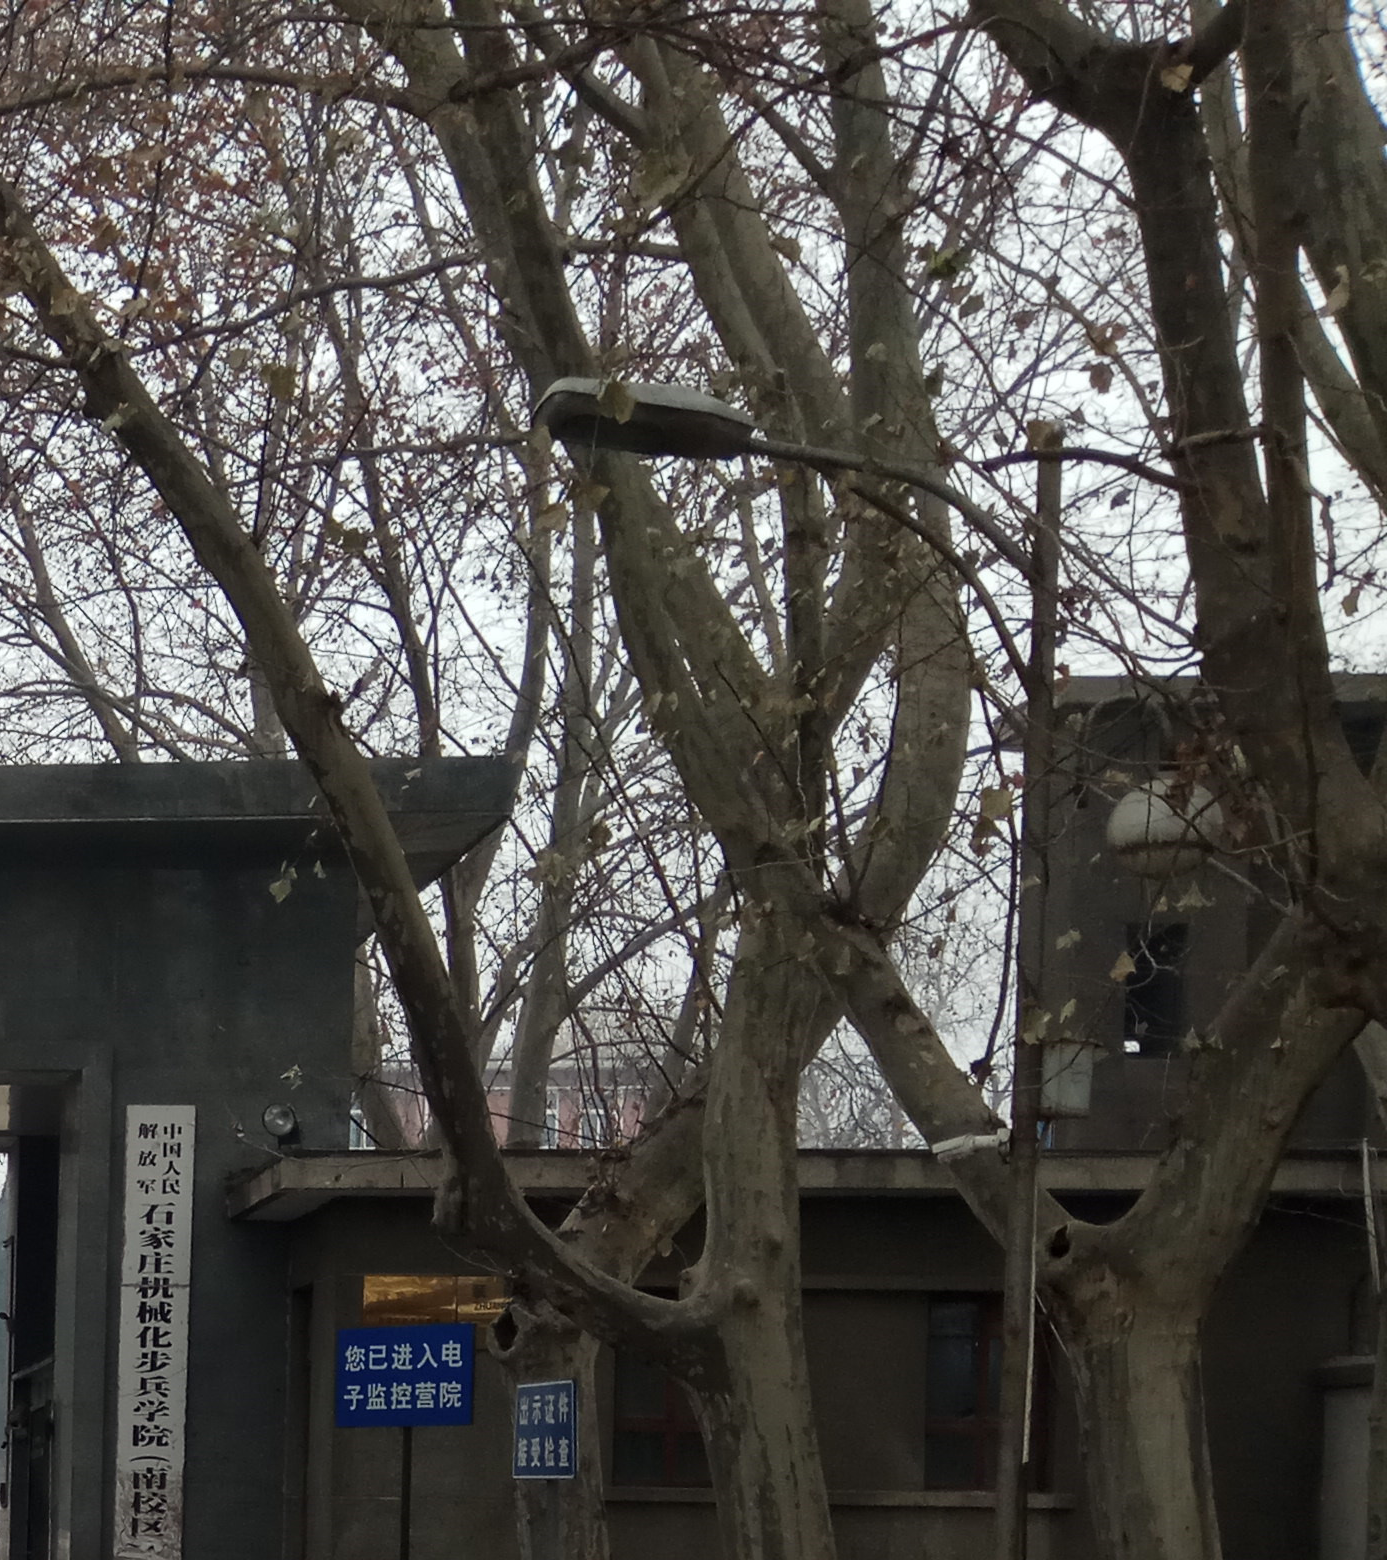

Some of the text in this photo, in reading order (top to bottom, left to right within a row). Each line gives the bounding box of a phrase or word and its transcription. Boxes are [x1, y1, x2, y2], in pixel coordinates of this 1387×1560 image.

[136, 1122, 159, 1195] 解放军
[161, 1122, 183, 1195] 中国人民
[343, 1338, 464, 1373] 您已进入电
[343, 1380, 463, 1412] 子监控营院
[518, 1391, 570, 1426] 出示证件
[516, 1434, 570, 1468] 接受检查
